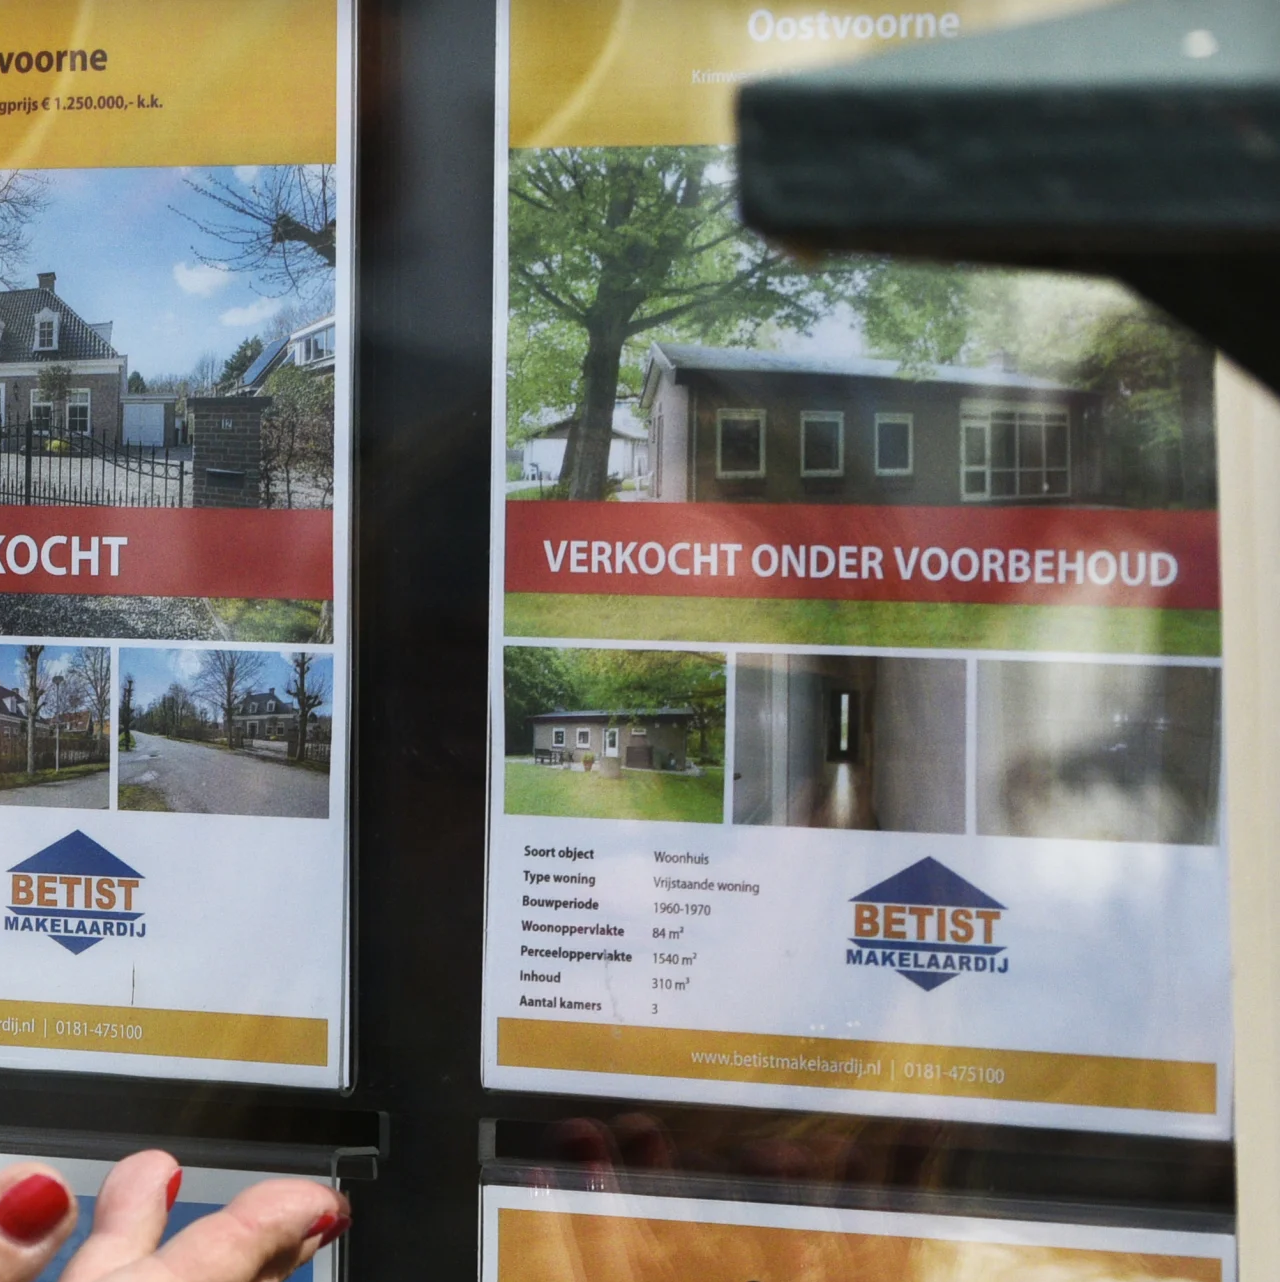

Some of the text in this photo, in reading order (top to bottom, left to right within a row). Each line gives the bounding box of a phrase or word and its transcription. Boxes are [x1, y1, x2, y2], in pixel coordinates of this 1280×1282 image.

[748, 9, 960, 42] Oostvoorne
[137, 94, 163, 108] k.k.
[543, 540, 1179, 588] VERKOCHT ONDER VOORBEHOUD
[524, 846, 594, 862] Soort object
[654, 851, 709, 865] Woonhuis
[523, 871, 596, 887] Type woning
[654, 877, 759, 895] Vrijstaande woning
[11, 874, 139, 911] BETIST
[523, 896, 599, 910] Bouwperiode
[654, 902, 711, 916] 1960-1970
[5, 916, 146, 938] MAKELAARDIJ
[522, 921, 624, 937] Woonoppervlakte
[854, 904, 1001, 945] BETIST
[652, 928, 665, 939] 84
[521, 946, 632, 962] Perceeloppervlakte
[653, 953, 679, 965] 1540
[846, 949, 1009, 974] MAKELAARDIJ
[520, 971, 560, 983] Inhoud
[652, 978, 672, 990] 310
[520, 996, 602, 1011] Aantal kamers
[652, 1004, 658, 1014] 3
[56, 1021, 142, 1039] 0181-475100
[691, 1050, 1004, 1084] www.betistmakelaardij.nl 0181-475100
